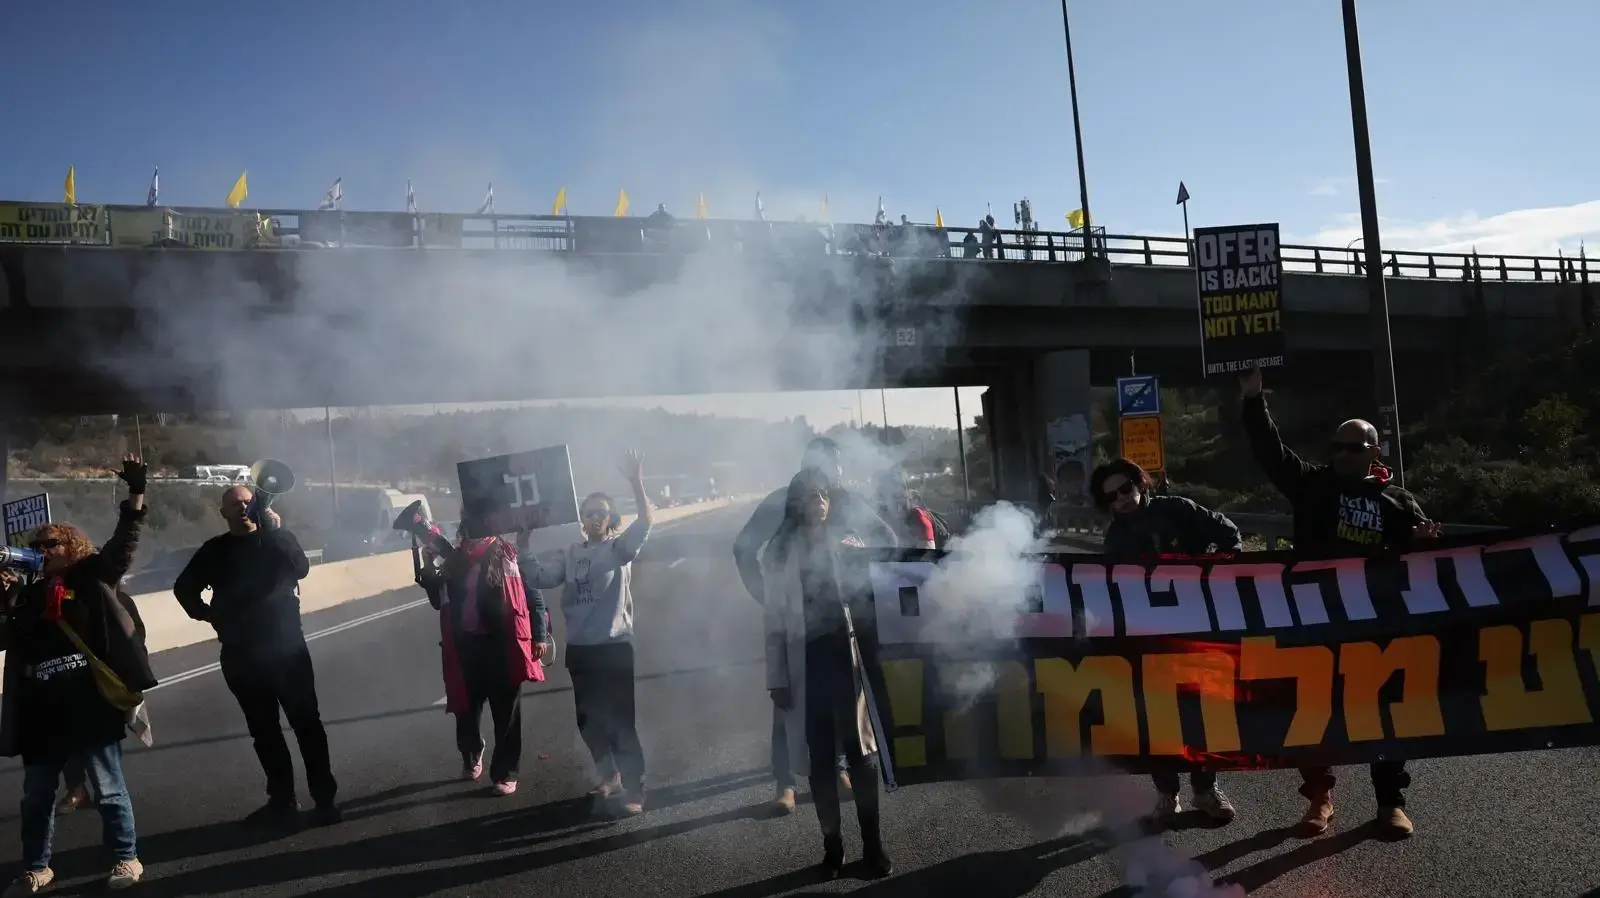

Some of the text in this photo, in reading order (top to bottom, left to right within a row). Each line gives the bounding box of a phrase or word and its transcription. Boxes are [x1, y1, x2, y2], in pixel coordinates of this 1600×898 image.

[1199, 229, 1277, 267] OFER
[1200, 264, 1278, 291] IS BACK!
[1202, 291, 1278, 316] TOO MANY
[1204, 310, 1281, 340] NOT YET!
[1207, 362, 1226, 374] UNTIL
[1226, 360, 1238, 373] THE
[1238, 359, 1253, 371] LAST
[6, 496, 45, 517] תוציאו
